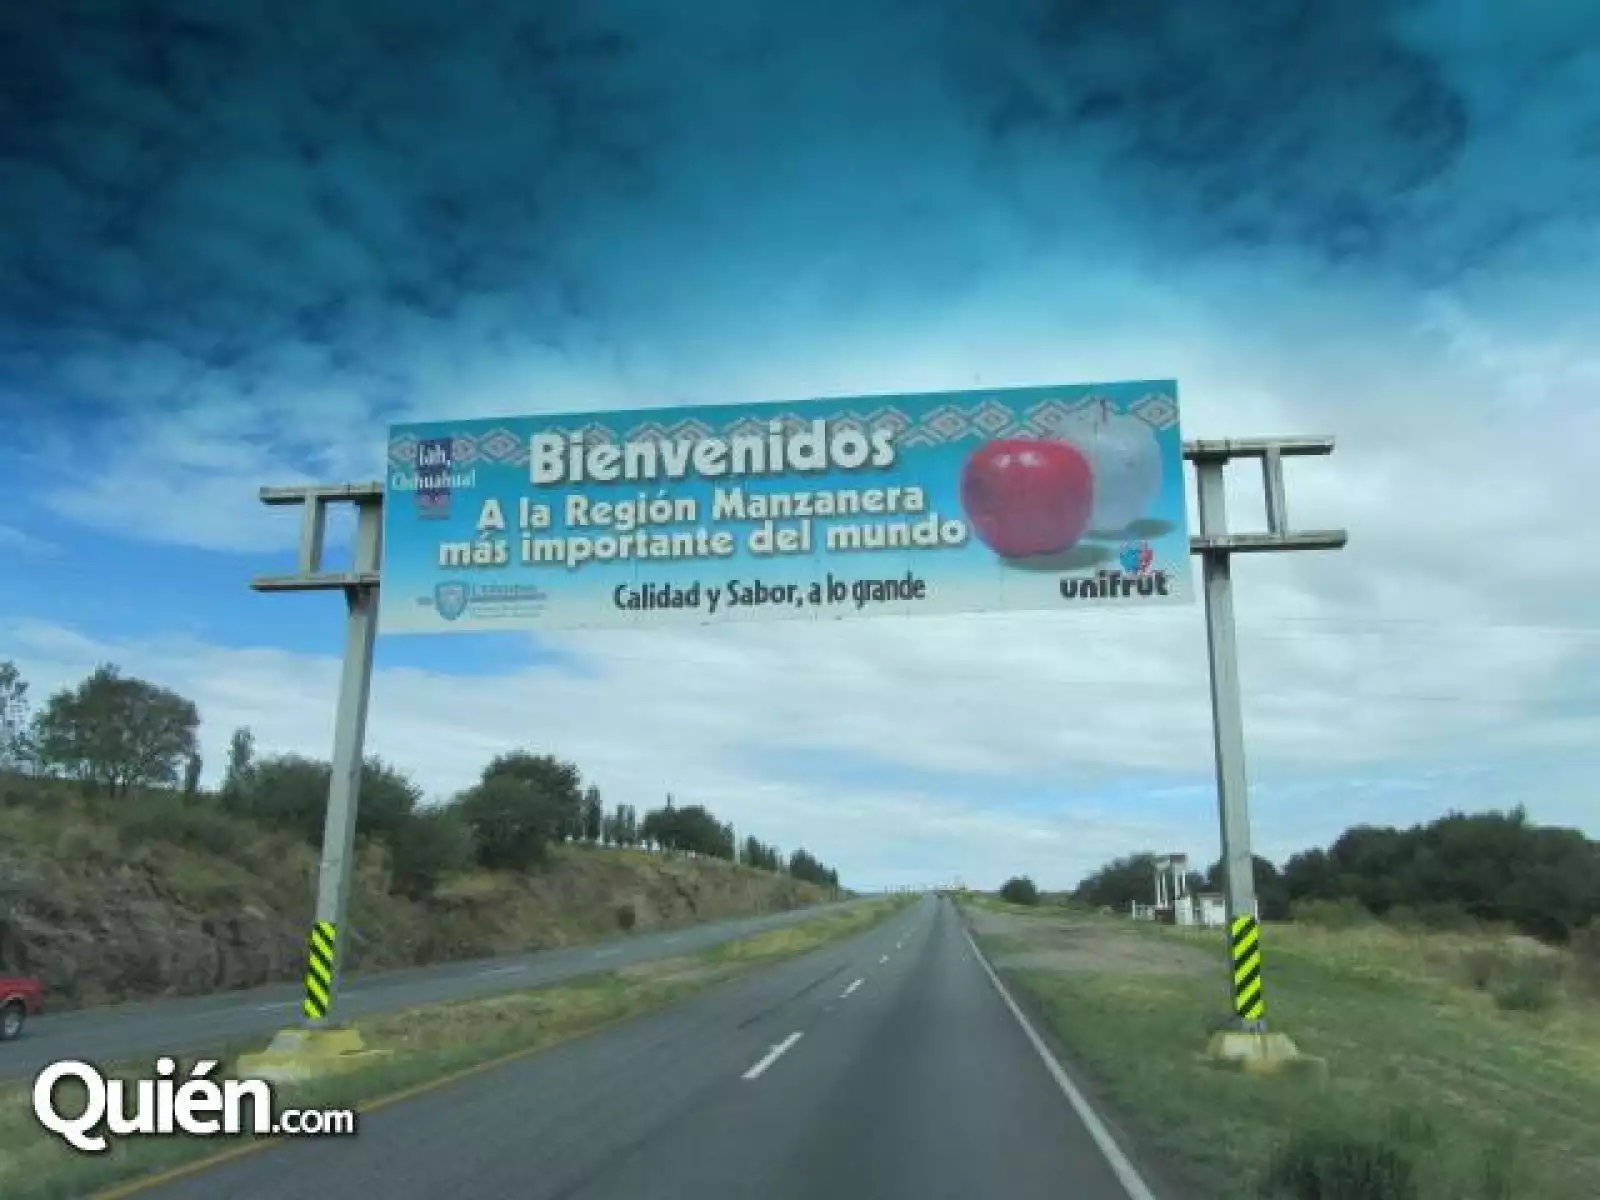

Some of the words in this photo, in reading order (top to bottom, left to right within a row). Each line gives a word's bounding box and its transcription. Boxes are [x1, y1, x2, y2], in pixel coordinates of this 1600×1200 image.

[530, 420, 895, 484] Bienvenidos
[476, 499, 505, 531] A
[519, 497, 550, 527] la
[565, 490, 696, 530] Región
[712, 486, 923, 520] Manzanera
[439, 532, 507, 565] más
[522, 532, 734, 567] importante
[748, 521, 811, 553] del
[826, 513, 966, 549] mundo
[614, 581, 700, 610] Calidad
[707, 588, 720, 615] y
[727, 579, 803, 609] Sabor,
[808, 581, 821, 605] a
[827, 572, 845, 605] lo
[852, 570, 925, 610] grande
[1060, 569, 1168, 598] unifrut
